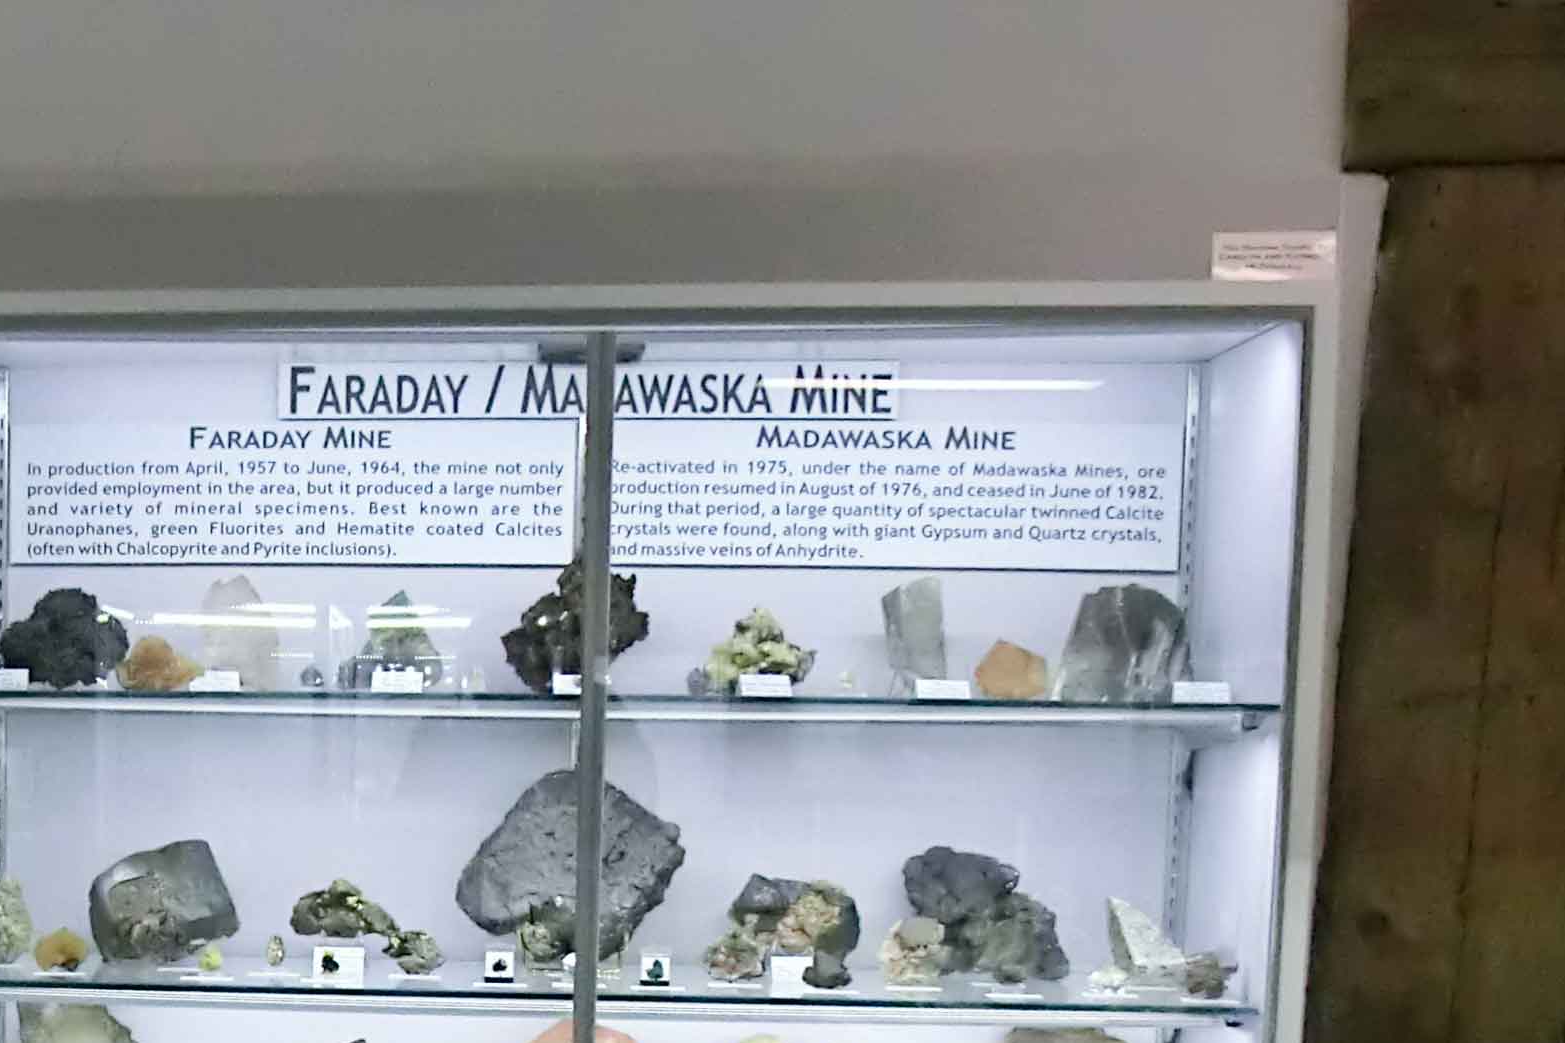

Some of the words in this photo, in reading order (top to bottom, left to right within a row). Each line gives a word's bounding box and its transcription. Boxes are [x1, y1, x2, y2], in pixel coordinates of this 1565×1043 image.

[289, 365, 468, 415] FARADAY
[520, 364, 771, 415] MAAWASKA
[789, 364, 893, 414] MINE
[189, 427, 312, 449] FARADAY
[323, 425, 392, 449] MINE
[757, 425, 932, 449] MADAWASKA
[944, 426, 1016, 450] MINE
[28, 463, 41, 475] In
[48, 462, 134, 479] production
[142, 461, 178, 475] from
[185, 461, 228, 477] April,
[239, 461, 276, 474] 1957
[284, 462, 299, 474] to
[307, 461, 351, 476] June,
[362, 461, 405, 477] 1964,
[414, 461, 440, 474] the
[447, 462, 487, 474] mine
[495, 463, 520, 475] not
[528, 461, 563, 478] only
[723, 460, 736, 474] in
[747, 460, 792, 476] 1975,
[802, 461, 850, 474] under
[859, 461, 886, 475] the
[895, 465, 941, 476] name
[948, 462, 965, 476] of
[973, 462, 1067, 477] Madawaska
[1074, 464, 1128, 480] Mines,
[1138, 468, 1165, 478] ore
[28, 481, 97, 499] provided
[103, 481, 202, 498] employment
[208, 482, 222, 495] in
[228, 481, 254, 495] the
[260, 484, 300, 496] area,
[307, 480, 332, 495] but
[340, 481, 350, 495] it
[356, 480, 433, 497] produced
[439, 484, 447, 495] a
[454, 481, 493, 498] large
[500, 482, 562, 496] number
[704, 481, 778, 495] resumed
[781, 482, 796, 494] in
[800, 482, 854, 499] August
[859, 482, 876, 496] of
[881, 482, 927, 498] 1976,
[932, 483, 962, 497] and
[967, 484, 1025, 498] ceased
[1030, 485, 1044, 498] in
[1049, 484, 1090, 498] June
[1095, 485, 1111, 498] of
[1117, 485, 1163, 500] 1982.
[28, 502, 57, 516] and
[71, 502, 132, 518] variety
[145, 501, 162, 515] of
[175, 501, 242, 515] mineral
[255, 502, 355, 518] specimens.
[369, 501, 406, 515] Best
[420, 501, 477, 516] known
[492, 505, 520, 515] are
[534, 502, 562, 516] the
[668, 501, 700, 515] that
[706, 501, 764, 518] period,
[772, 505, 780, 515] a
[786, 502, 827, 519] large
[833, 504, 902, 520] quantity
[907, 503, 924, 517] of
[929, 504, 1025, 520] spectacular
[1031, 505, 1100, 520] twinned
[1106, 506, 1164, 520] Calcite
[28, 522, 138, 538] Uranophanes,
[151, 525, 197, 538] green
[210, 521, 283, 535] Fluorites
[296, 520, 324, 535] and
[337, 522, 414, 536] Hematite
[426, 522, 483, 536] coated
[496, 522, 562, 536] Calcites
[676, 525, 717, 536] were
[723, 522, 776, 538] found,
[782, 523, 827, 540] along
[833, 523, 869, 537] with
[875, 524, 916, 541] giant
[922, 524, 987, 541] Gypsum
[993, 526, 1022, 539] and
[1028, 525, 1085, 542] Quartz
[1092, 526, 1162, 544] crystals,
[28, 542, 74, 558] (often
[78, 542, 112, 555] with
[117, 541, 217, 558] Chalcopyrite
[221, 542, 250, 555] and
[254, 542, 300, 558] Pyrite
[306, 542, 396, 558] inclusions).
[641, 543, 704, 556] massive
[709, 544, 752, 557] veins
[756, 542, 772, 556] of
[776, 544, 863, 560] Anhydrite.
